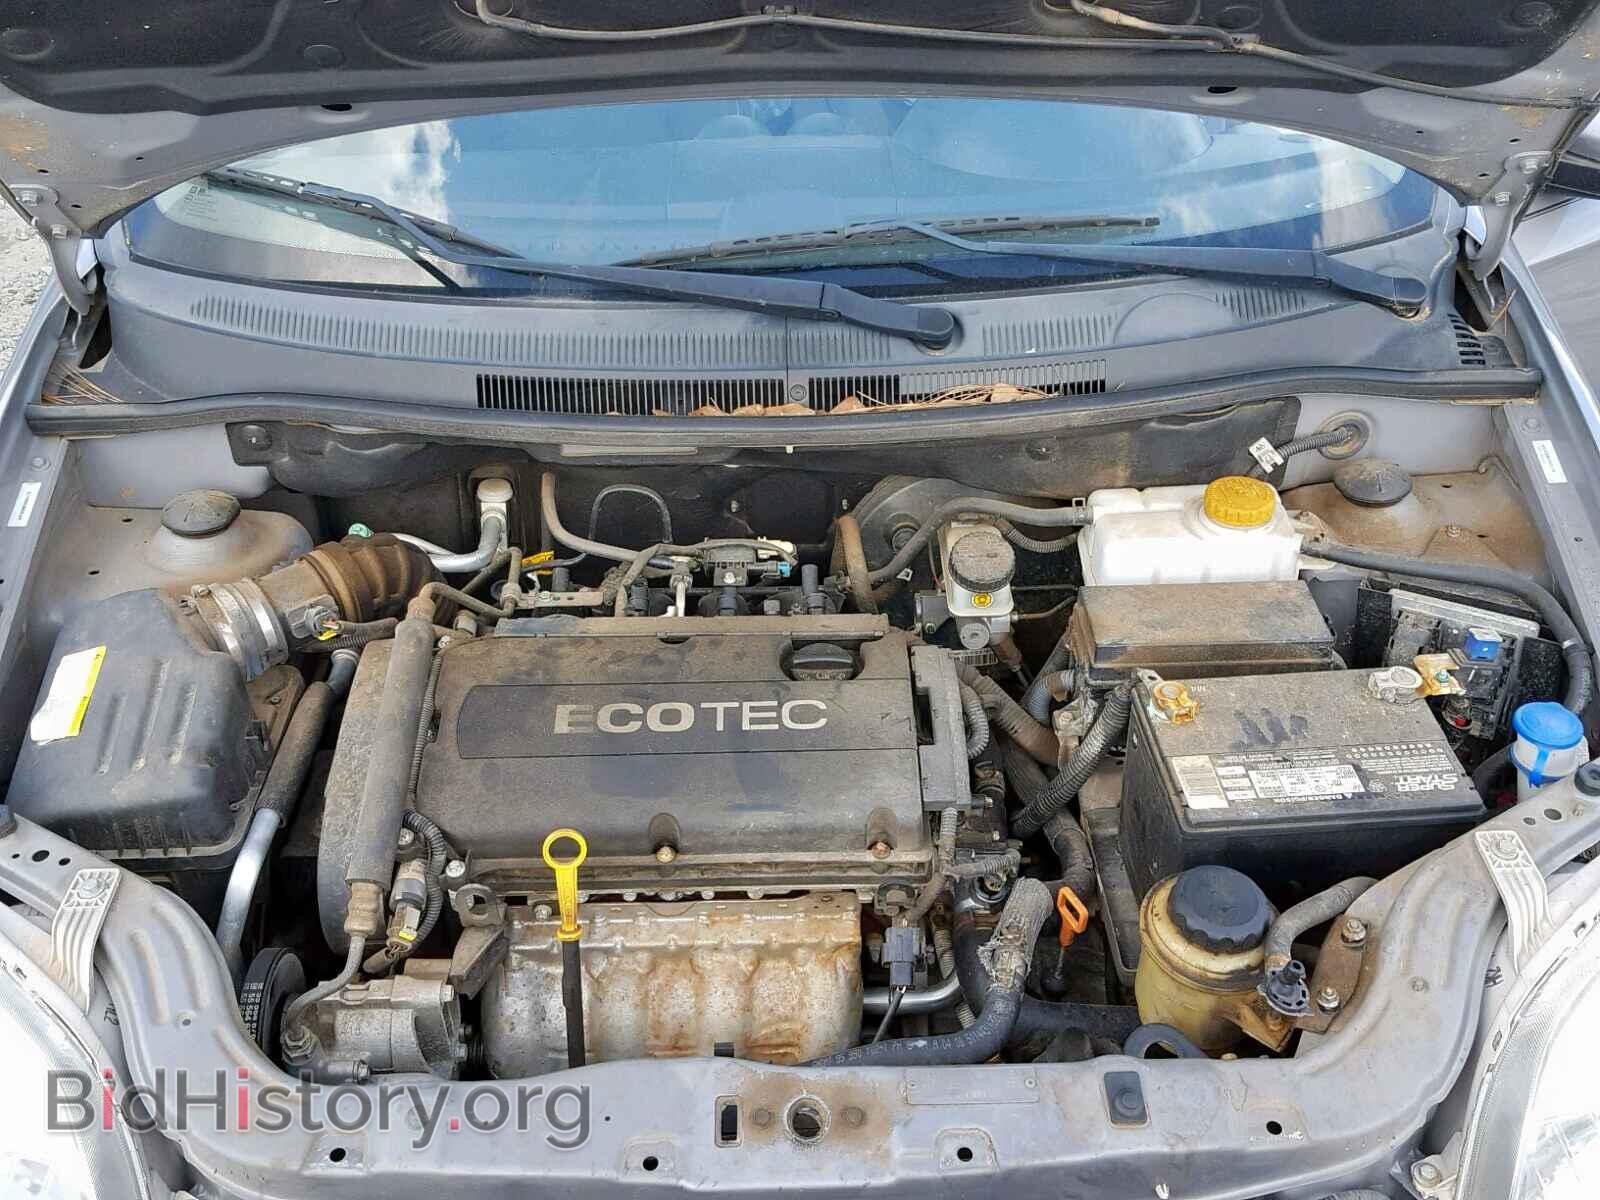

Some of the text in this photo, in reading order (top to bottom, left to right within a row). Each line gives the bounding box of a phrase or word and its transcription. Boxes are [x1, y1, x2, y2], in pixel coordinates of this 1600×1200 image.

[554, 700, 828, 734] ECOTEC
[1395, 773, 1459, 784] START
[1397, 782, 1456, 792] SUPER
